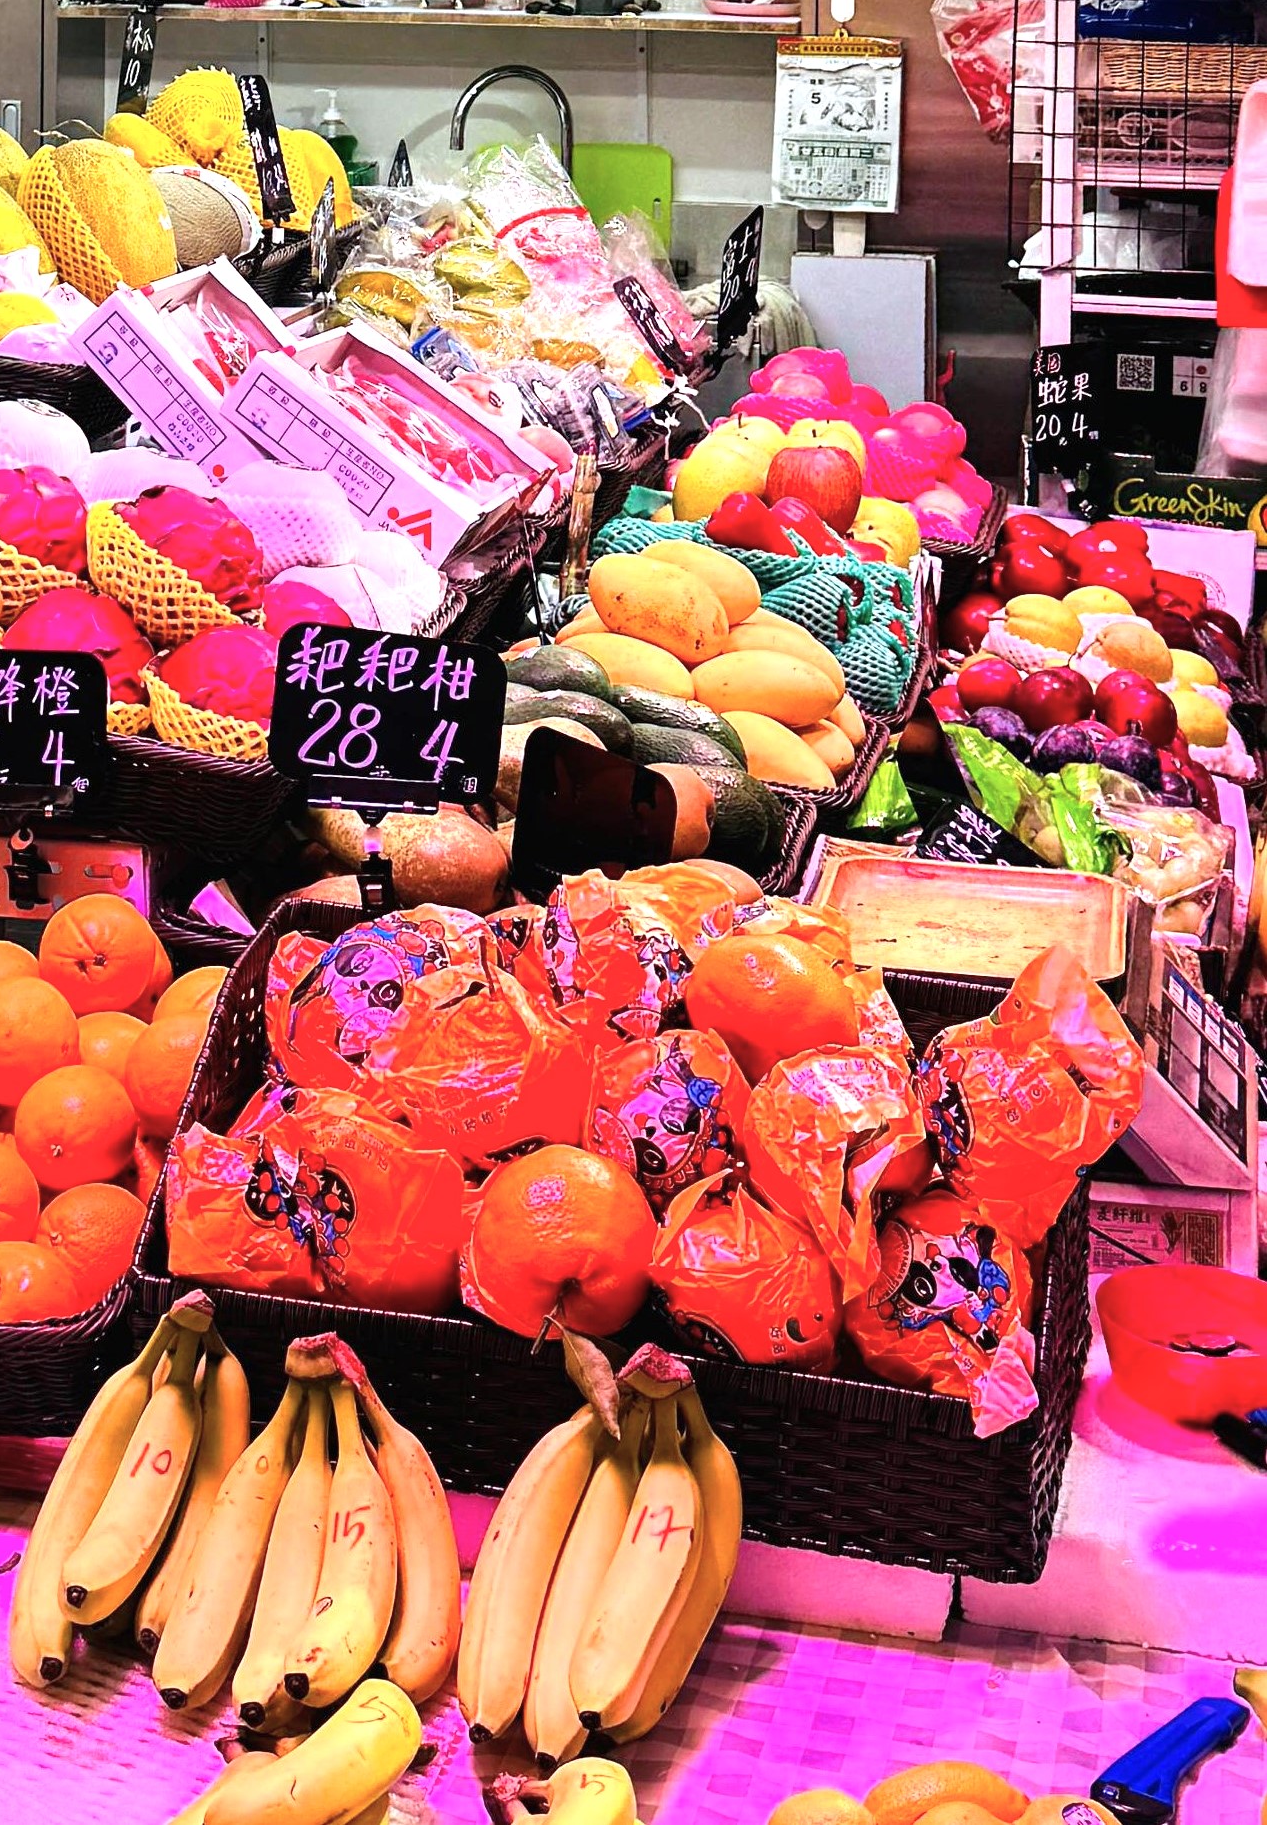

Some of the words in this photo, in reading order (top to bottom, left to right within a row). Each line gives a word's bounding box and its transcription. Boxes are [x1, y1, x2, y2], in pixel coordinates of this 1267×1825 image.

[124, 58, 140, 86] 10
[811, 92, 822, 105] 5
[1037, 372, 1093, 408] 蛇果
[1113, 477, 1246, 523] GreenSkin
[285, 625, 478, 712] 耙耙柑
[297, 697, 382, 769] 28
[130, 1441, 173, 1478] 10
[331, 1505, 371, 1549] 15
[631, 1504, 694, 1553] 17
